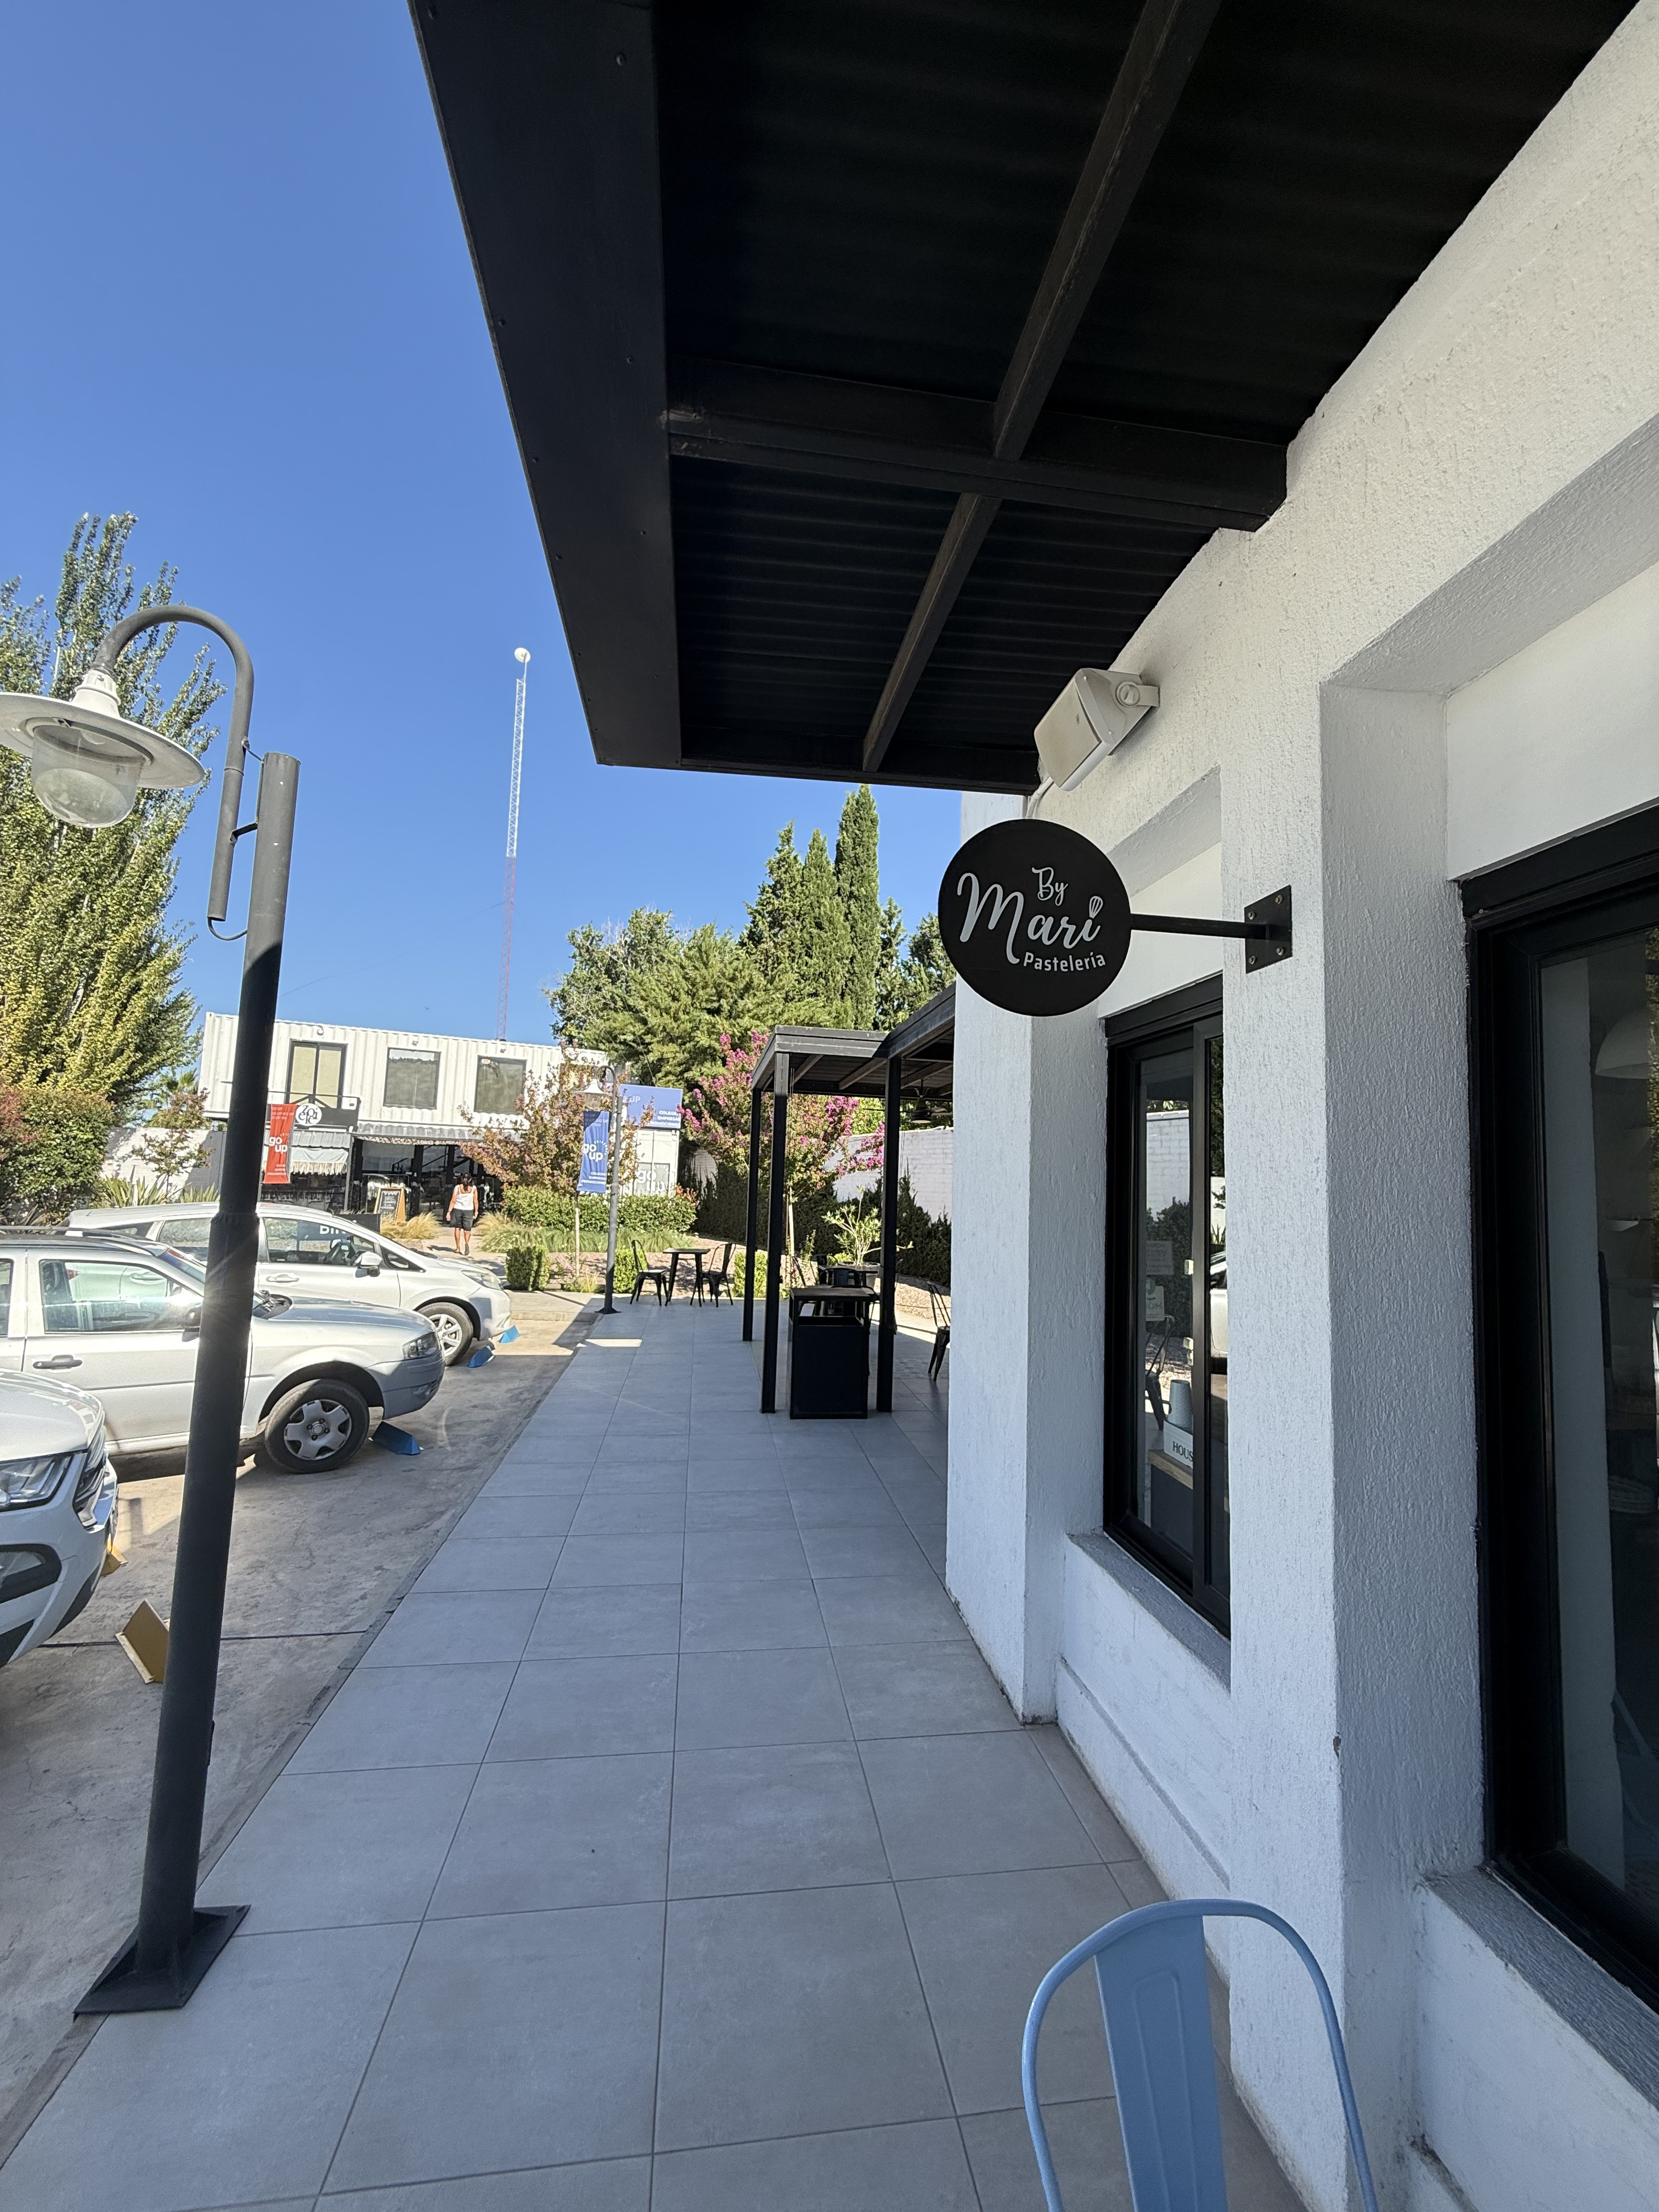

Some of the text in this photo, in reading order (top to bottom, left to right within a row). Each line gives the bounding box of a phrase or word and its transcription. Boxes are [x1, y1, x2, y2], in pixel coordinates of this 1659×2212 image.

[1031, 866, 1069, 906] By
[957, 872, 1103, 964] Mari
[1023, 951, 1106, 972] Pastelería
[269, 1136, 283, 1147] go
[275, 1144, 288, 1154] up
[583, 1143, 597, 1154] go
[589, 1152, 603, 1163] up
[636, 1170, 657, 1183] go
